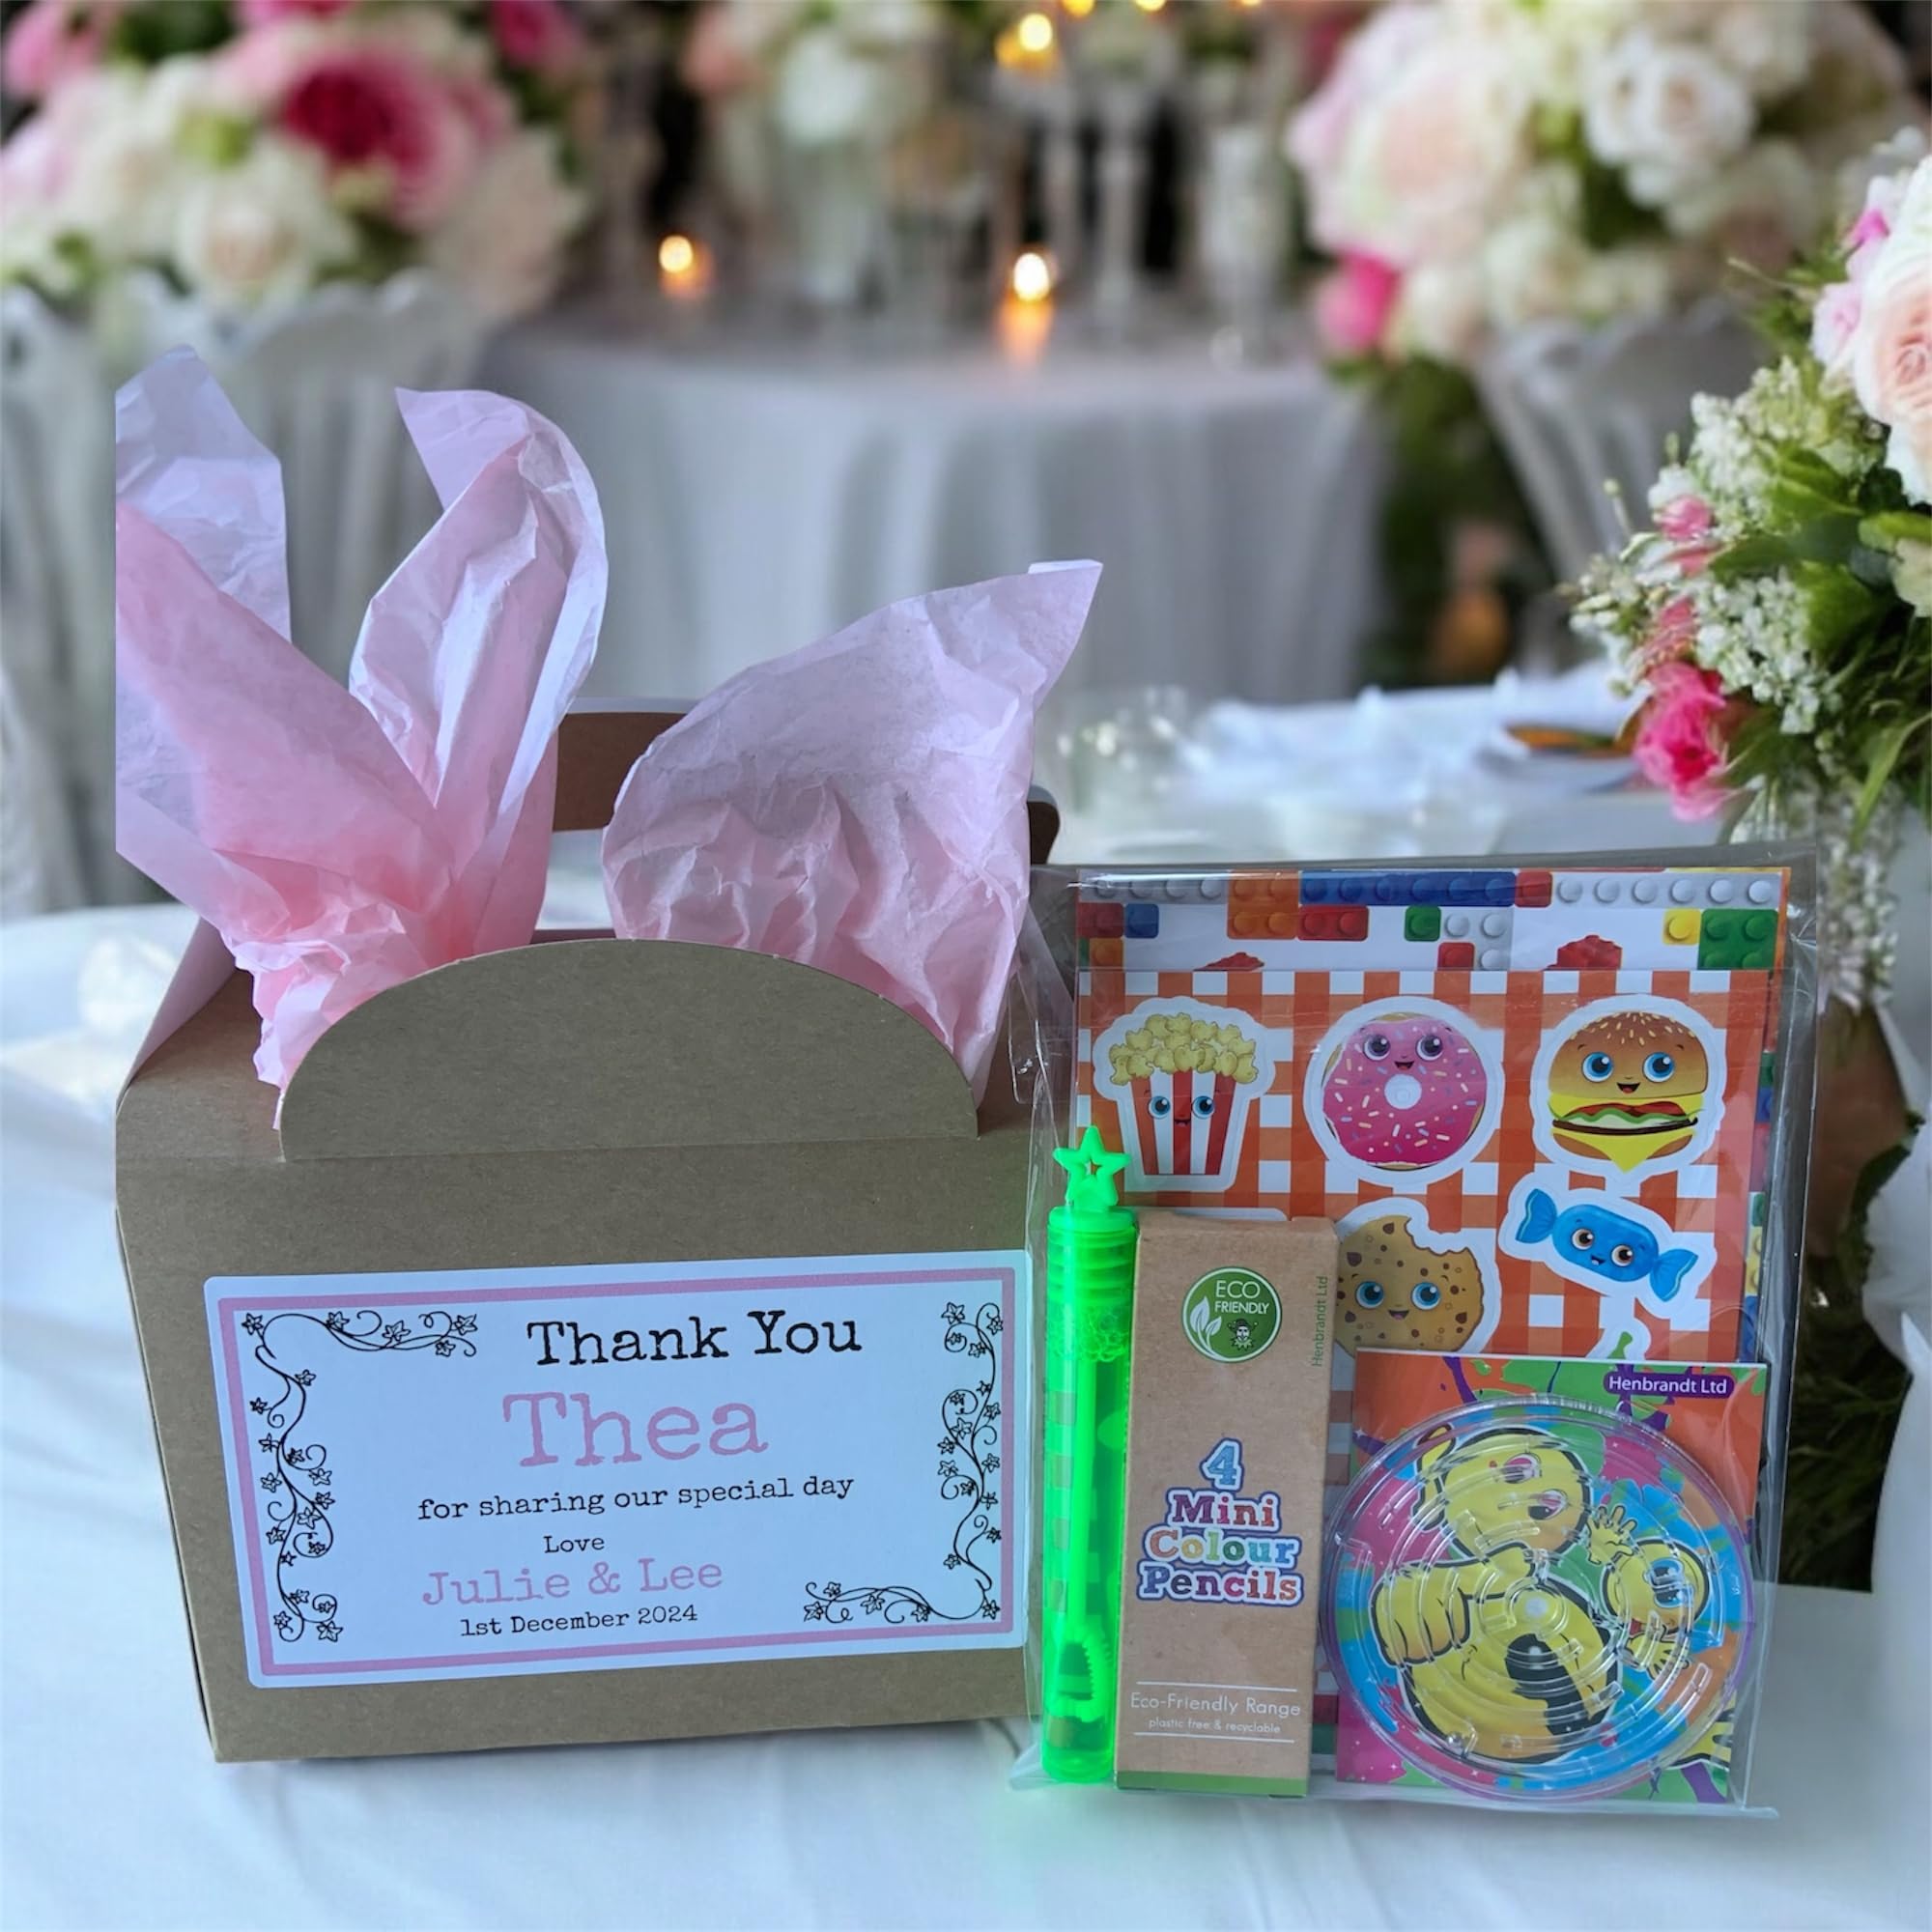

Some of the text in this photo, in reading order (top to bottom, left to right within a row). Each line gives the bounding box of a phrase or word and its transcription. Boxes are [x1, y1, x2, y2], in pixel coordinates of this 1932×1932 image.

[1215, 1280, 1260, 1298] ECO
[1215, 1301, 1269, 1314] FRIENDLY
[527, 1310, 862, 1365] Thank You
[1312, 1276, 1328, 1367] Henbrandt Ltd
[1608, 1376, 1727, 1394] Henbrandt Ltd
[502, 1392, 768, 1466] Thea
[1204, 1440, 1241, 1488] 4
[417, 1476, 854, 1520] for sharing our special day
[1169, 1492, 1277, 1529] Mini
[544, 1536, 605, 1553] Love
[1147, 1527, 1297, 1566] Colour
[422, 1558, 723, 1605] Julie & Lee
[1140, 1564, 1300, 1602] Pencils
[460, 1605, 697, 1636] 1st December 2024
[1130, 1692, 1301, 1719] Eco-Friendly Range
[1149, 1718, 1281, 1733] plastic free & recyclable
